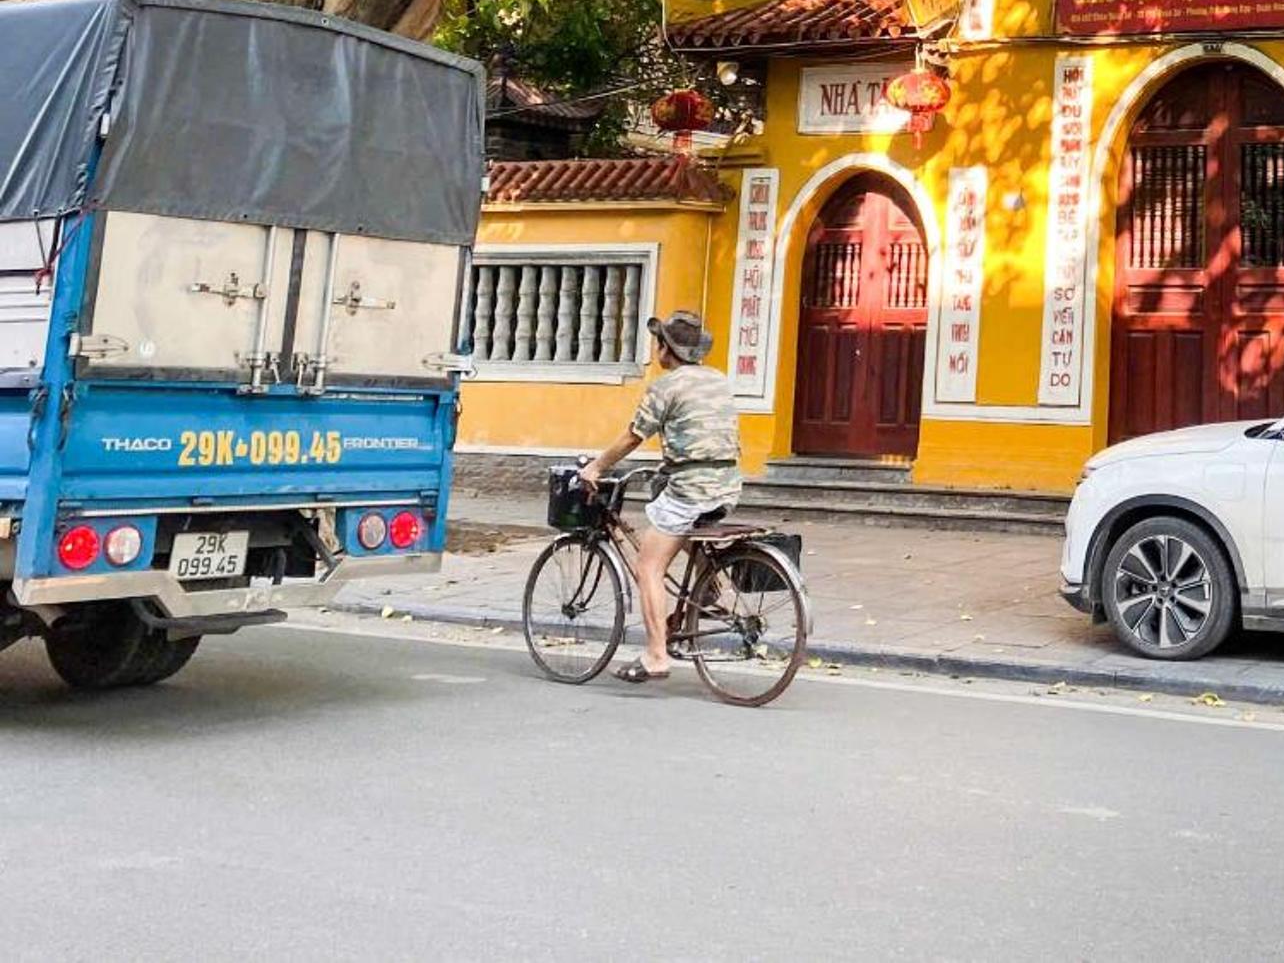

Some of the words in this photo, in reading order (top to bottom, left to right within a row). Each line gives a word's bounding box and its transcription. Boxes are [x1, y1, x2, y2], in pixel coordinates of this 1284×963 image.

[102, 438, 172, 451] THACO
[344, 437, 418, 449] FRONTIER
[195, 535, 227, 554] 29K
[178, 555, 238, 577] 099.45
